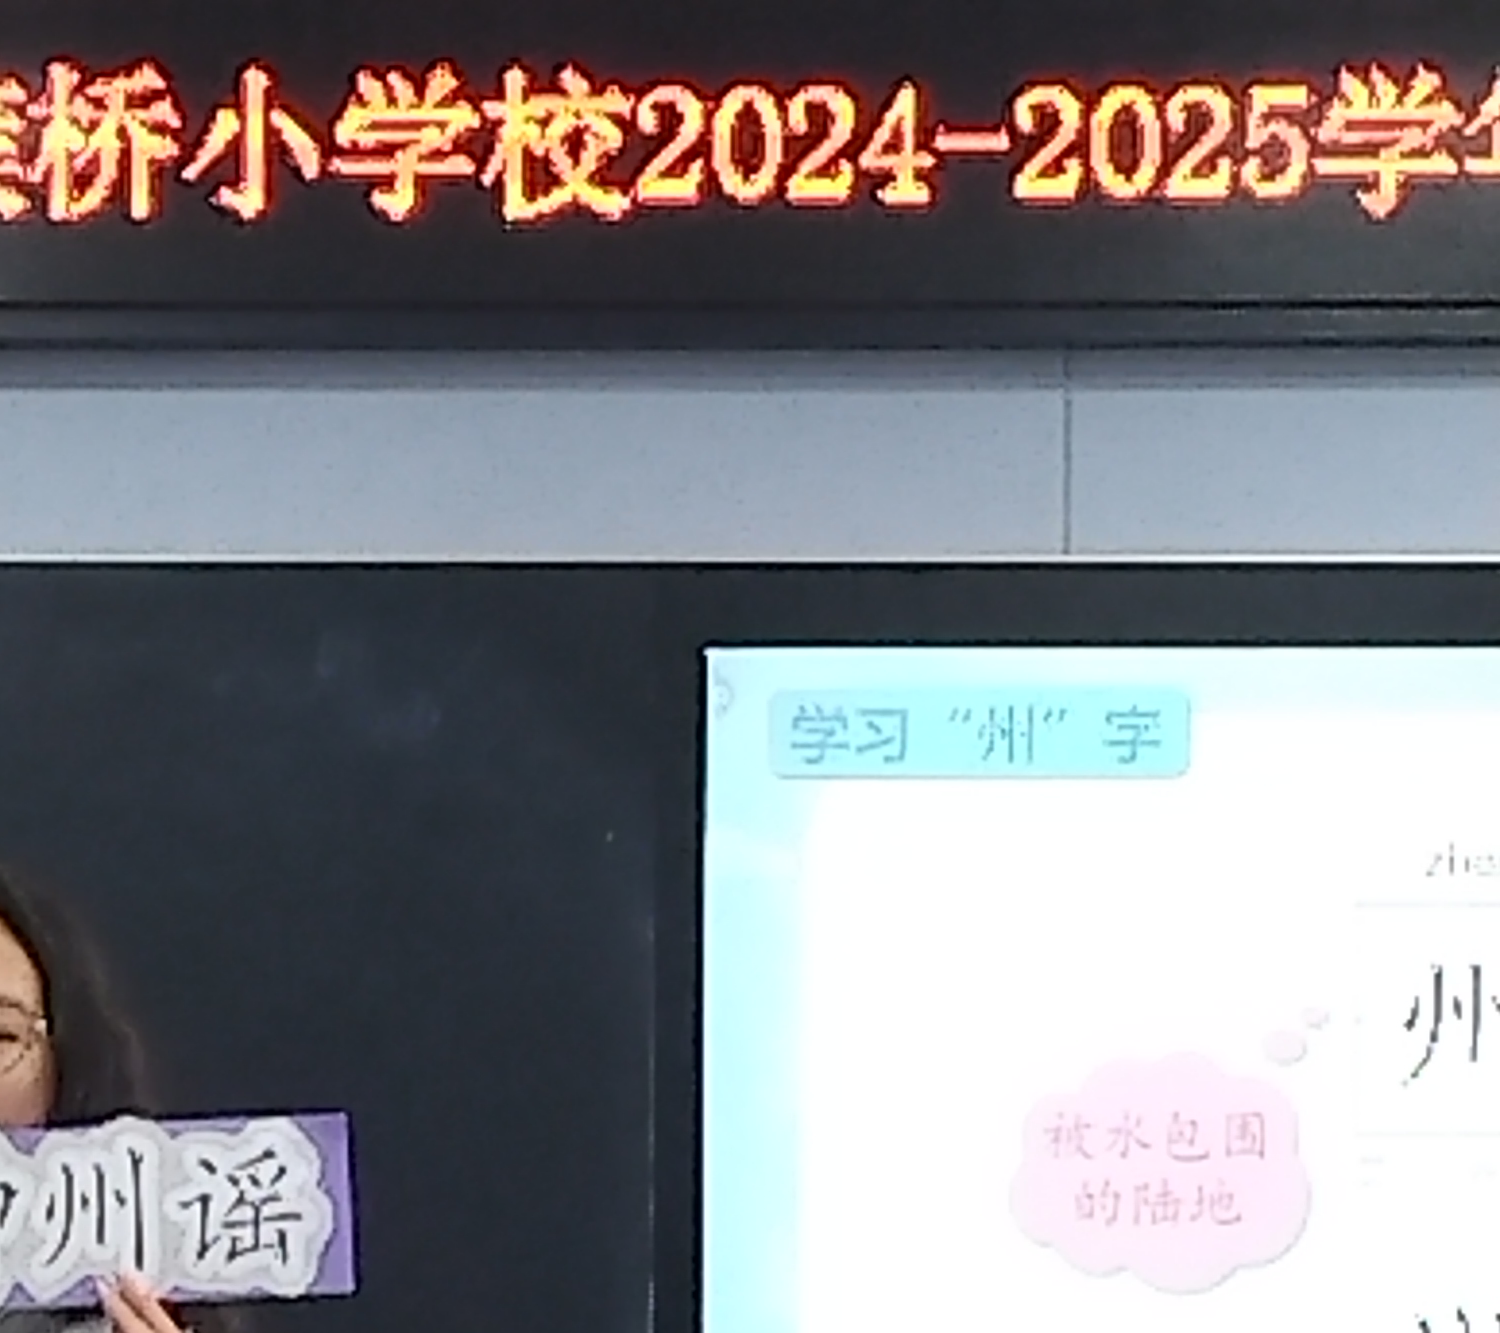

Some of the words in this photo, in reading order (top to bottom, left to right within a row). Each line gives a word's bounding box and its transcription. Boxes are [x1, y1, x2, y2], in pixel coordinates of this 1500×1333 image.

[1043, 1110, 1266, 1162] 被水包围
[1074, 1177, 1242, 1227] 的陆地
